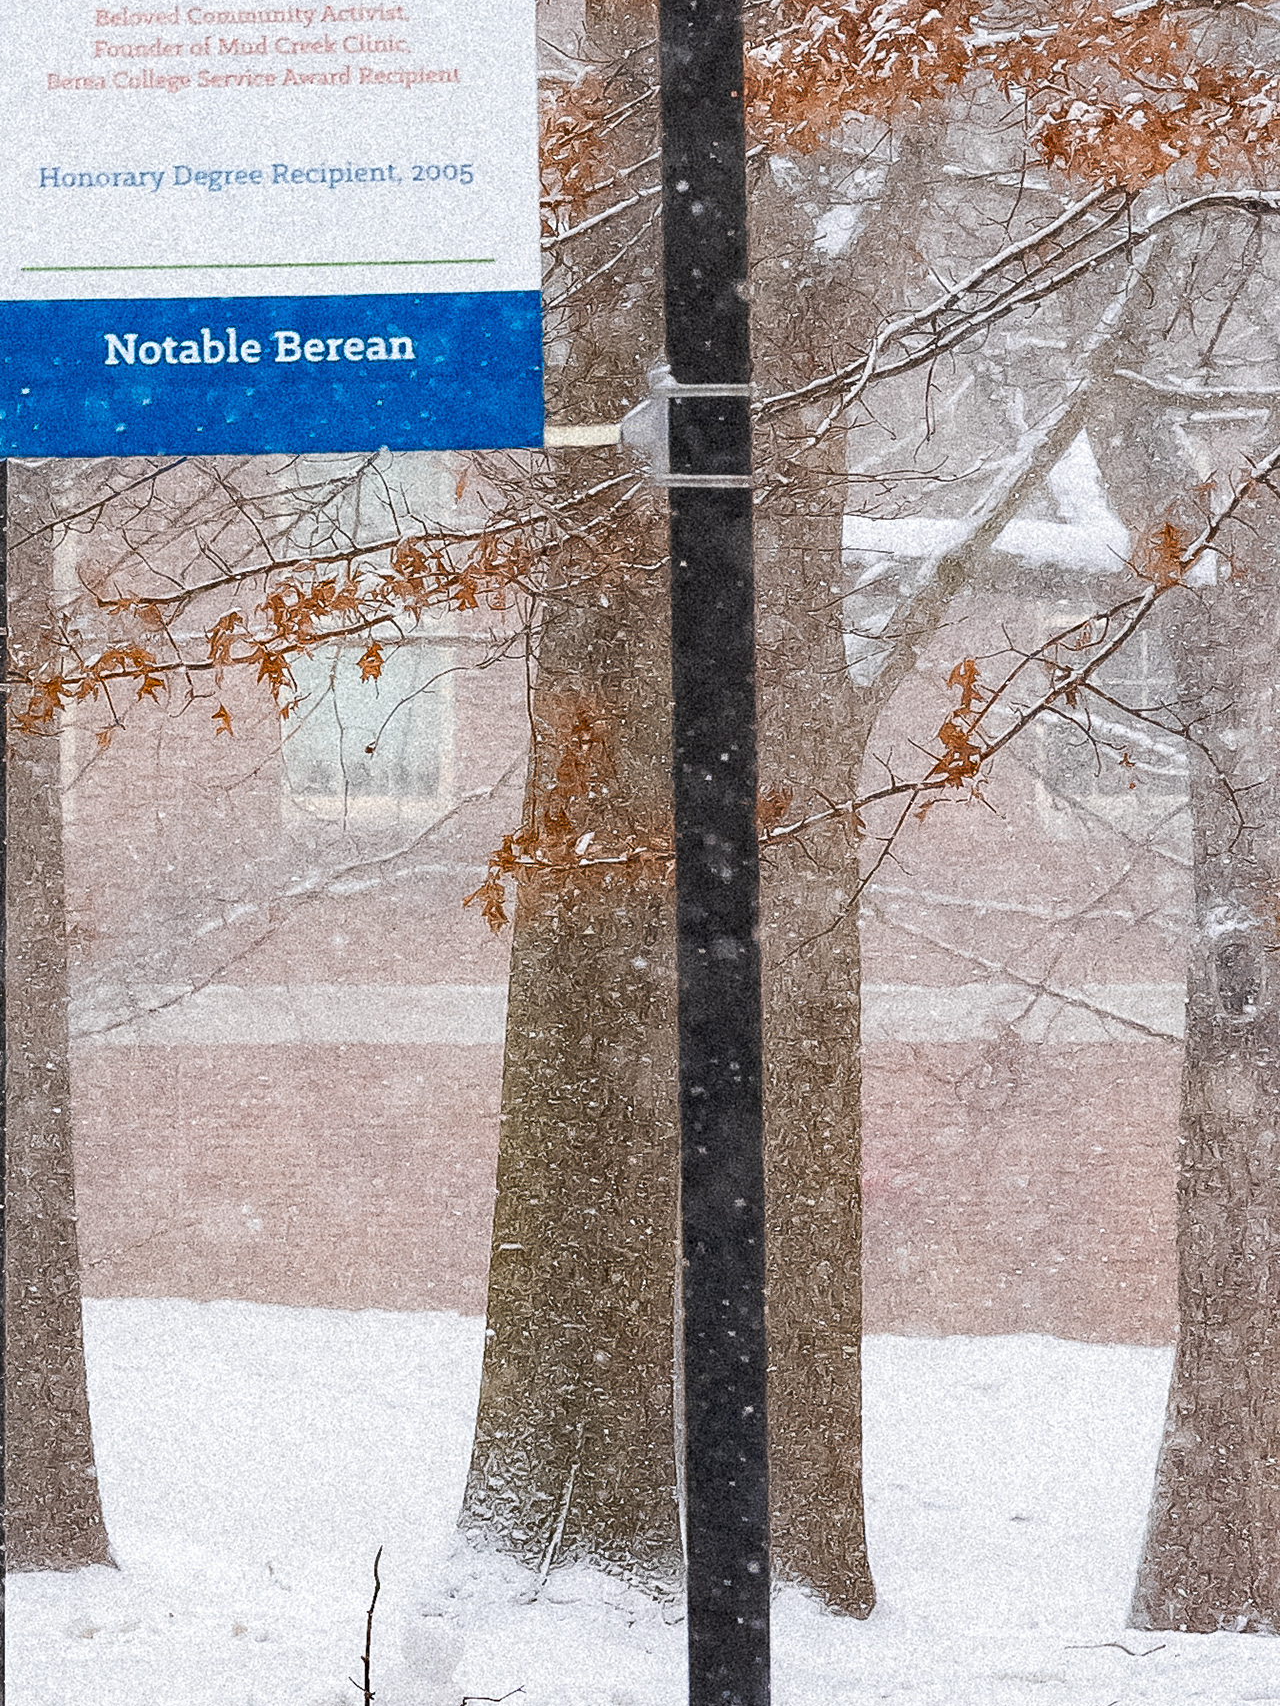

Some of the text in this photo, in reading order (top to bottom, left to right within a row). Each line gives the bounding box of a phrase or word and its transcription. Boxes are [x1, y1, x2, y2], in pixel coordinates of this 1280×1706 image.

[95, 8, 179, 26] Beloved
[188, 6, 316, 28] Community
[94, 39, 183, 58] Founder
[190, 37, 212, 57] of
[218, 37, 267, 55] Mud
[275, 36, 336, 55] Creek
[47, 67, 460, 93] Berea College Service Award Recipient
[39, 163, 475, 191] Honorary Degree Recipient, 2005
[104, 328, 415, 365] Notable Berean
